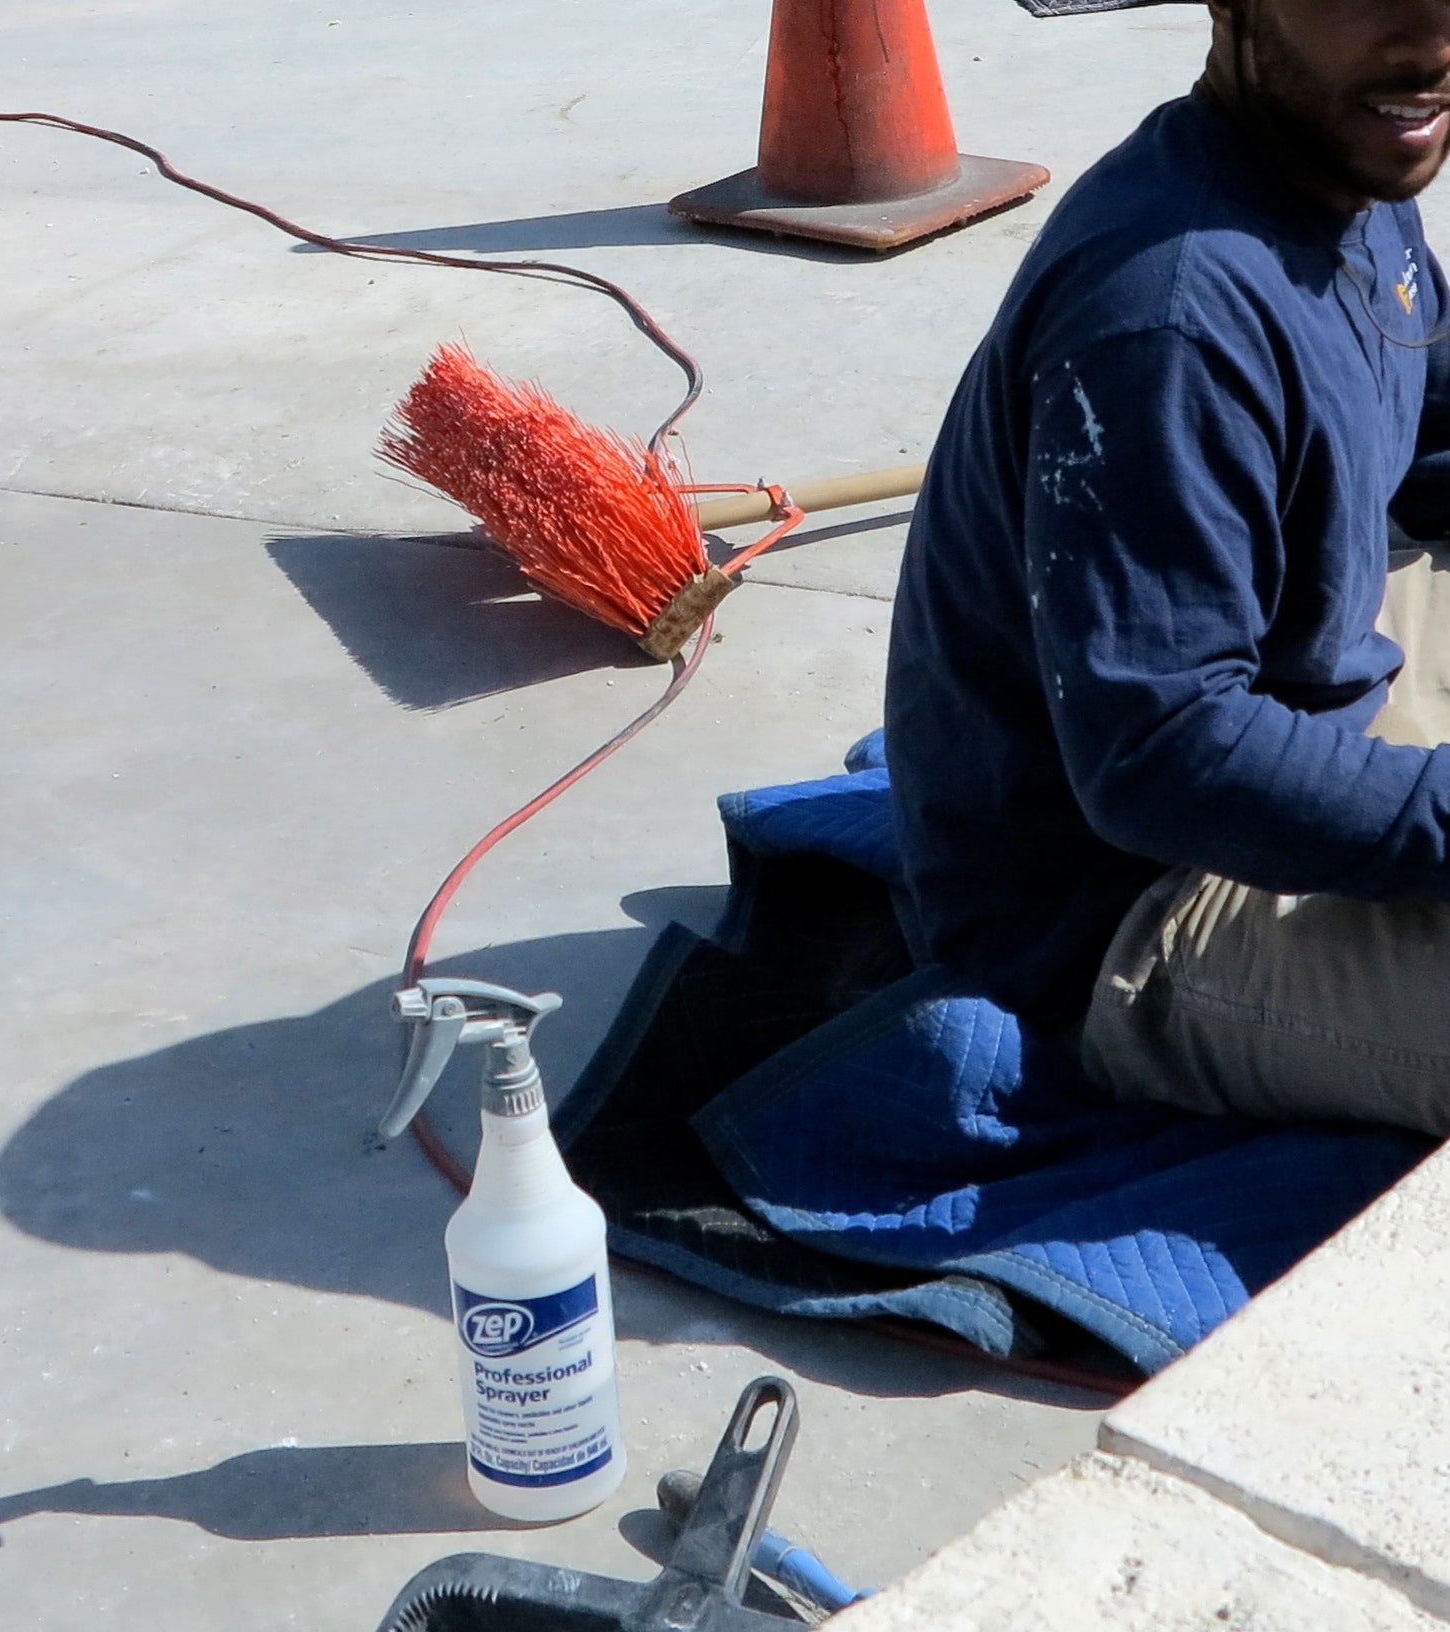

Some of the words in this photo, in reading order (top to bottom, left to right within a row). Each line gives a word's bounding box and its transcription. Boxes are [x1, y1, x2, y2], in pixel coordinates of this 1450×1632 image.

[474, 1351, 592, 1386] Professional
[476, 1379, 551, 1407] Sprayer
[532, 1453, 576, 1474] Capacidad
